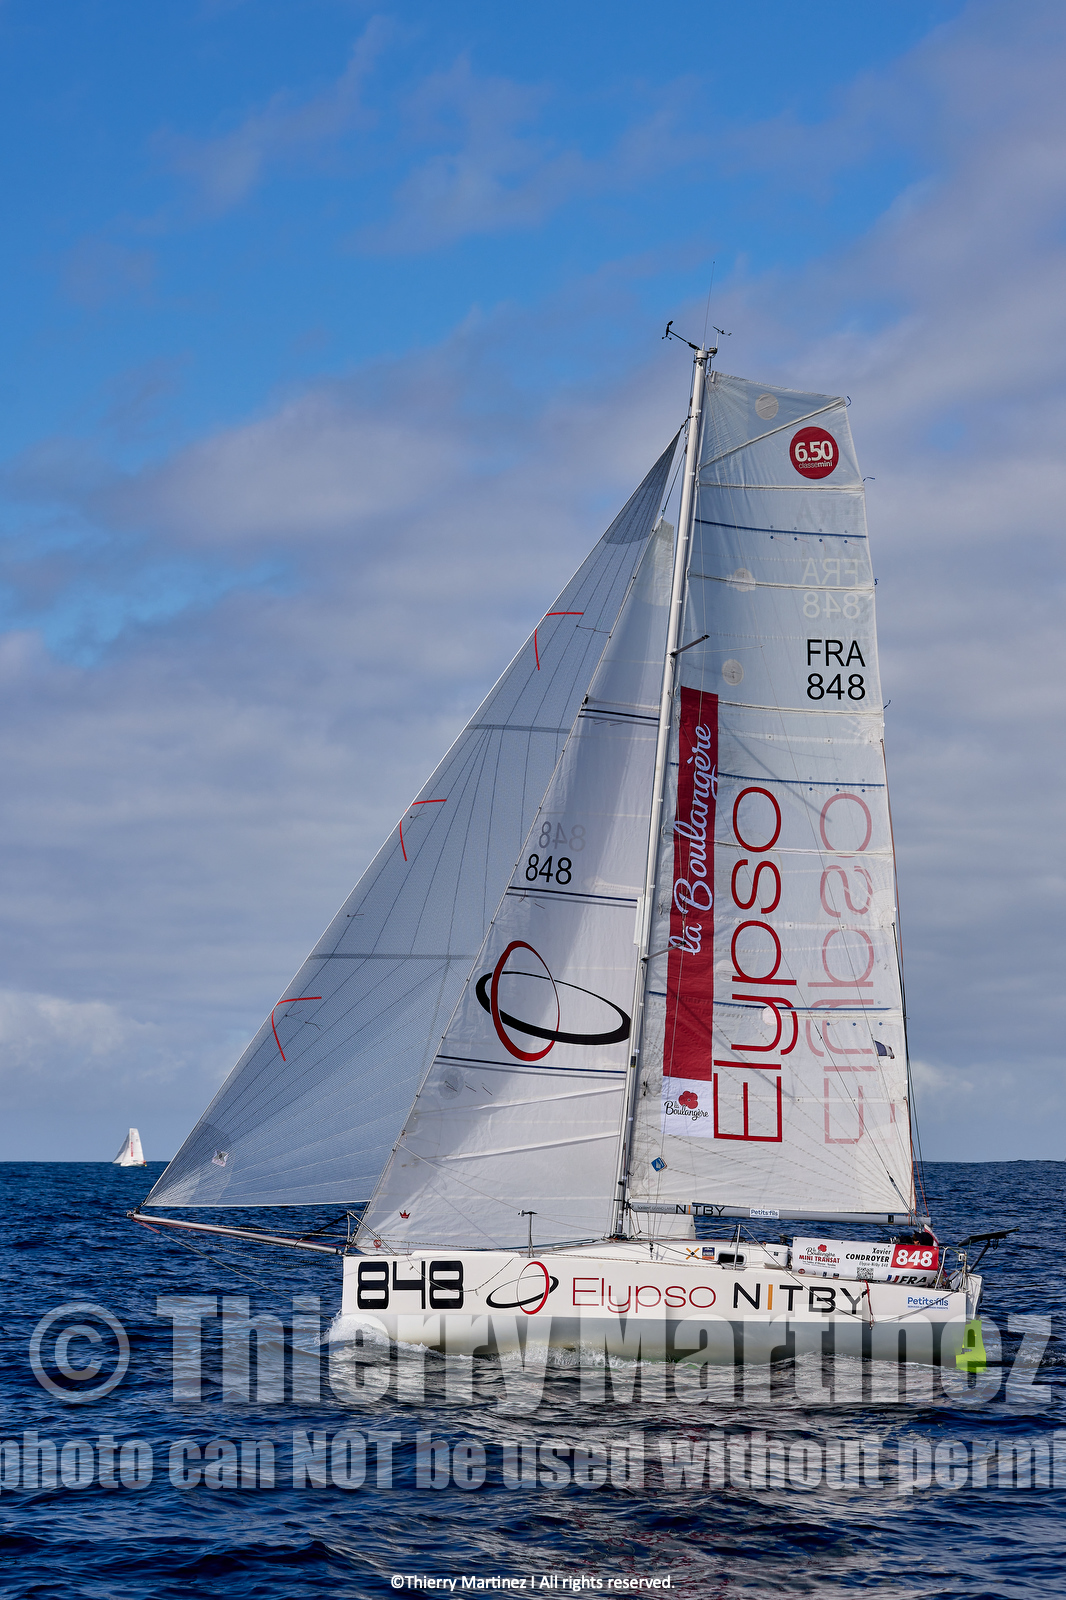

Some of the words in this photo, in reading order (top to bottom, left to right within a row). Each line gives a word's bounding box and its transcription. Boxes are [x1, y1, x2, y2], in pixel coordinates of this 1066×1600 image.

[795, 440, 834, 462] 6.50
[799, 460, 832, 469] classemini
[806, 639, 866, 667] FRA
[806, 673, 866, 700] 848
[673, 723, 718, 914] Boulangère
[525, 854, 572, 885] 848
[714, 786, 798, 1142] Elypso
[664, 1101, 709, 1121] Boulangère
[676, 1204, 726, 1216] NITBY
[815, 1256, 840, 1264] TRANSAT
[845, 1253, 890, 1263] CONDROYER
[872, 1247, 892, 1255] Xavier
[896, 1249, 933, 1268] 848
[357, 1260, 464, 1310] 848
[899, 1275, 928, 1285] FRA
[572, 1277, 717, 1314] Elypso
[733, 1282, 869, 1315] NITBY
